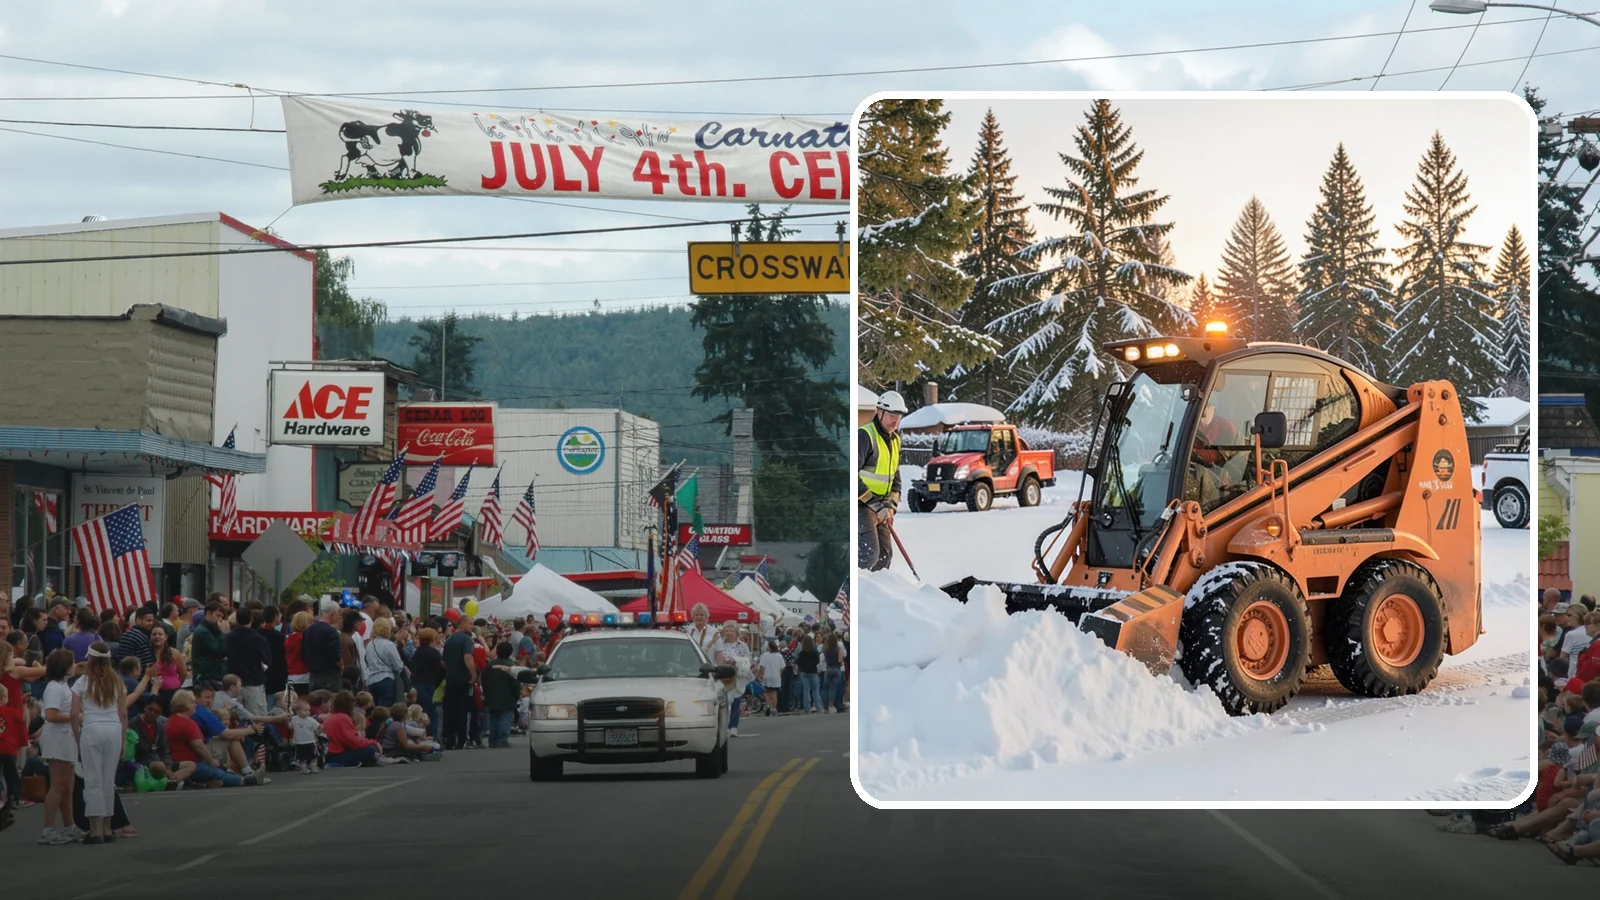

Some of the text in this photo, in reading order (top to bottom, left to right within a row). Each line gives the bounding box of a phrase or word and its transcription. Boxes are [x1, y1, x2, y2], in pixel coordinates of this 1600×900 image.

[694, 120, 850, 150] Carnat
[481, 140, 605, 193] JULY
[632, 149, 746, 198] 4th.
[696, 254, 850, 280] CROSSWA
[282, 379, 374, 420] ACE
[405, 408, 485, 423] CEDAR LOG
[283, 421, 371, 437] Hardware
[416, 427, 477, 447] Coca-Cola
[353, 467, 385, 481] Simpl
[83, 485, 155, 496] St. Vincent de Paul
[212, 516, 331, 536] HARDARE
[688, 526, 741, 535] CRNATION
[699, 535, 730, 543] GLASS
